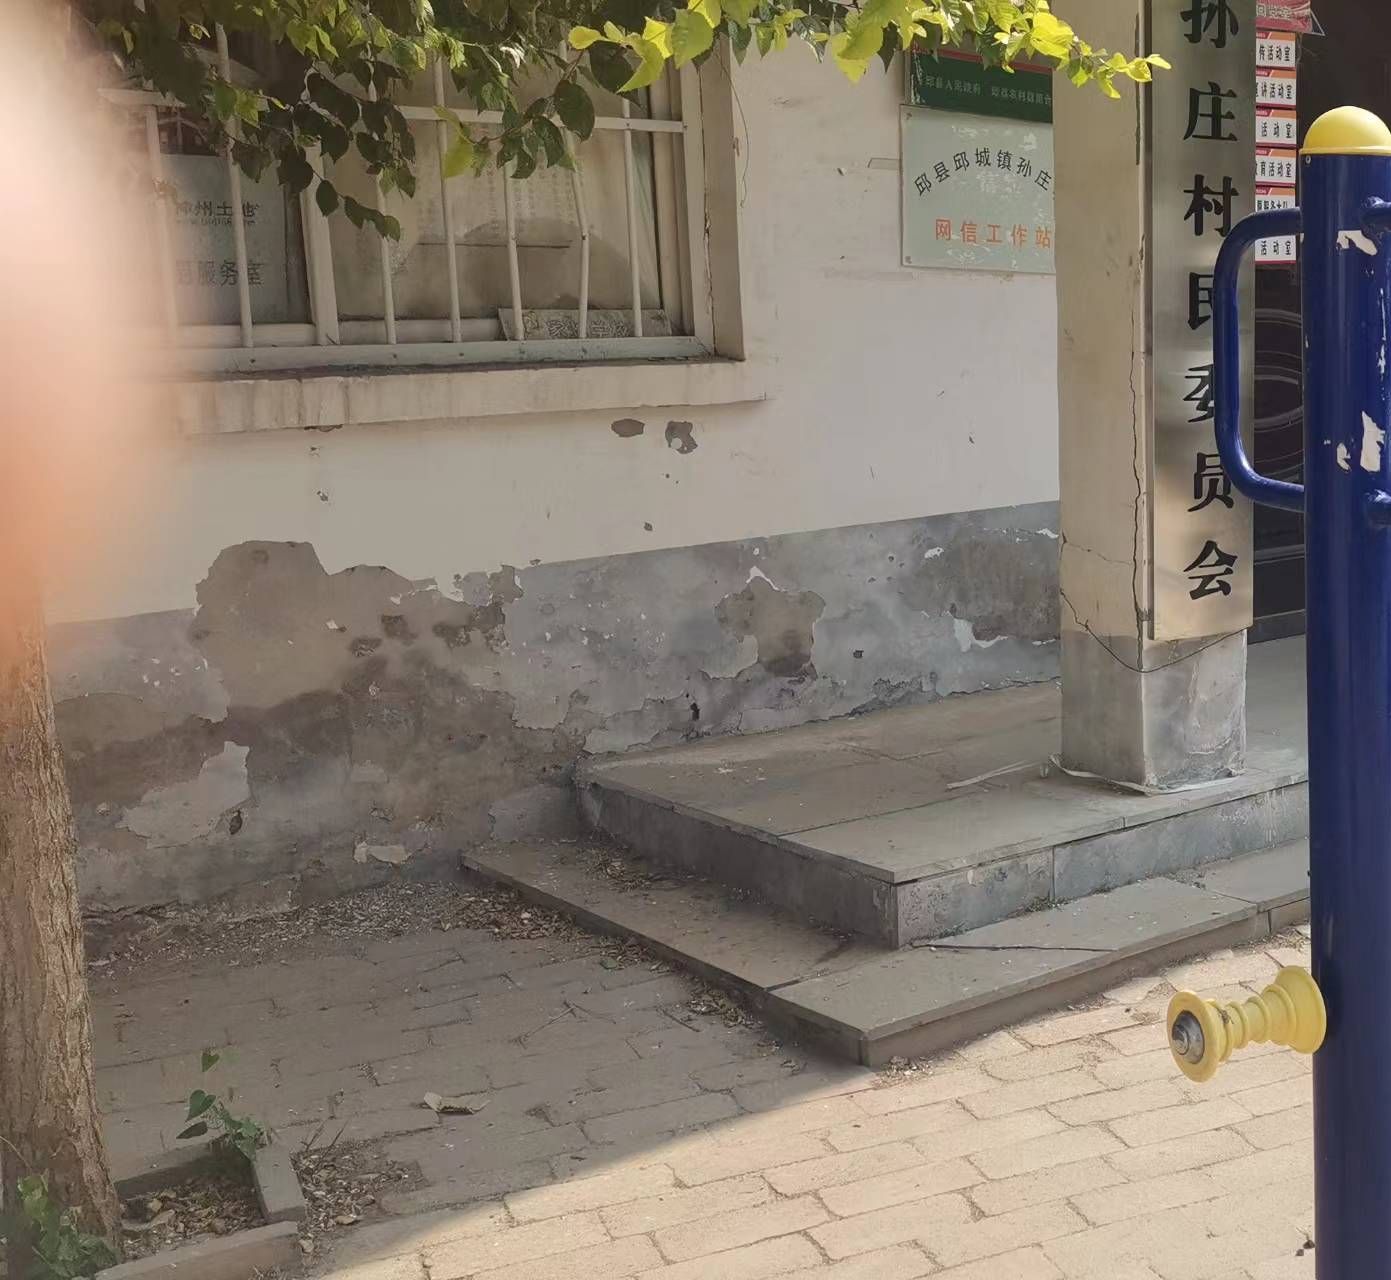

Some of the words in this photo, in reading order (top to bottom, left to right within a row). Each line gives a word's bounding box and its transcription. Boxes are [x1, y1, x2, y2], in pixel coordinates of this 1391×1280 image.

[913, 146, 1055, 197] 邱县邱城镇孙庄
[935, 218, 1051, 249] 网信工作站
[1179, 0, 1240, 600] 孙庄村民委员会
